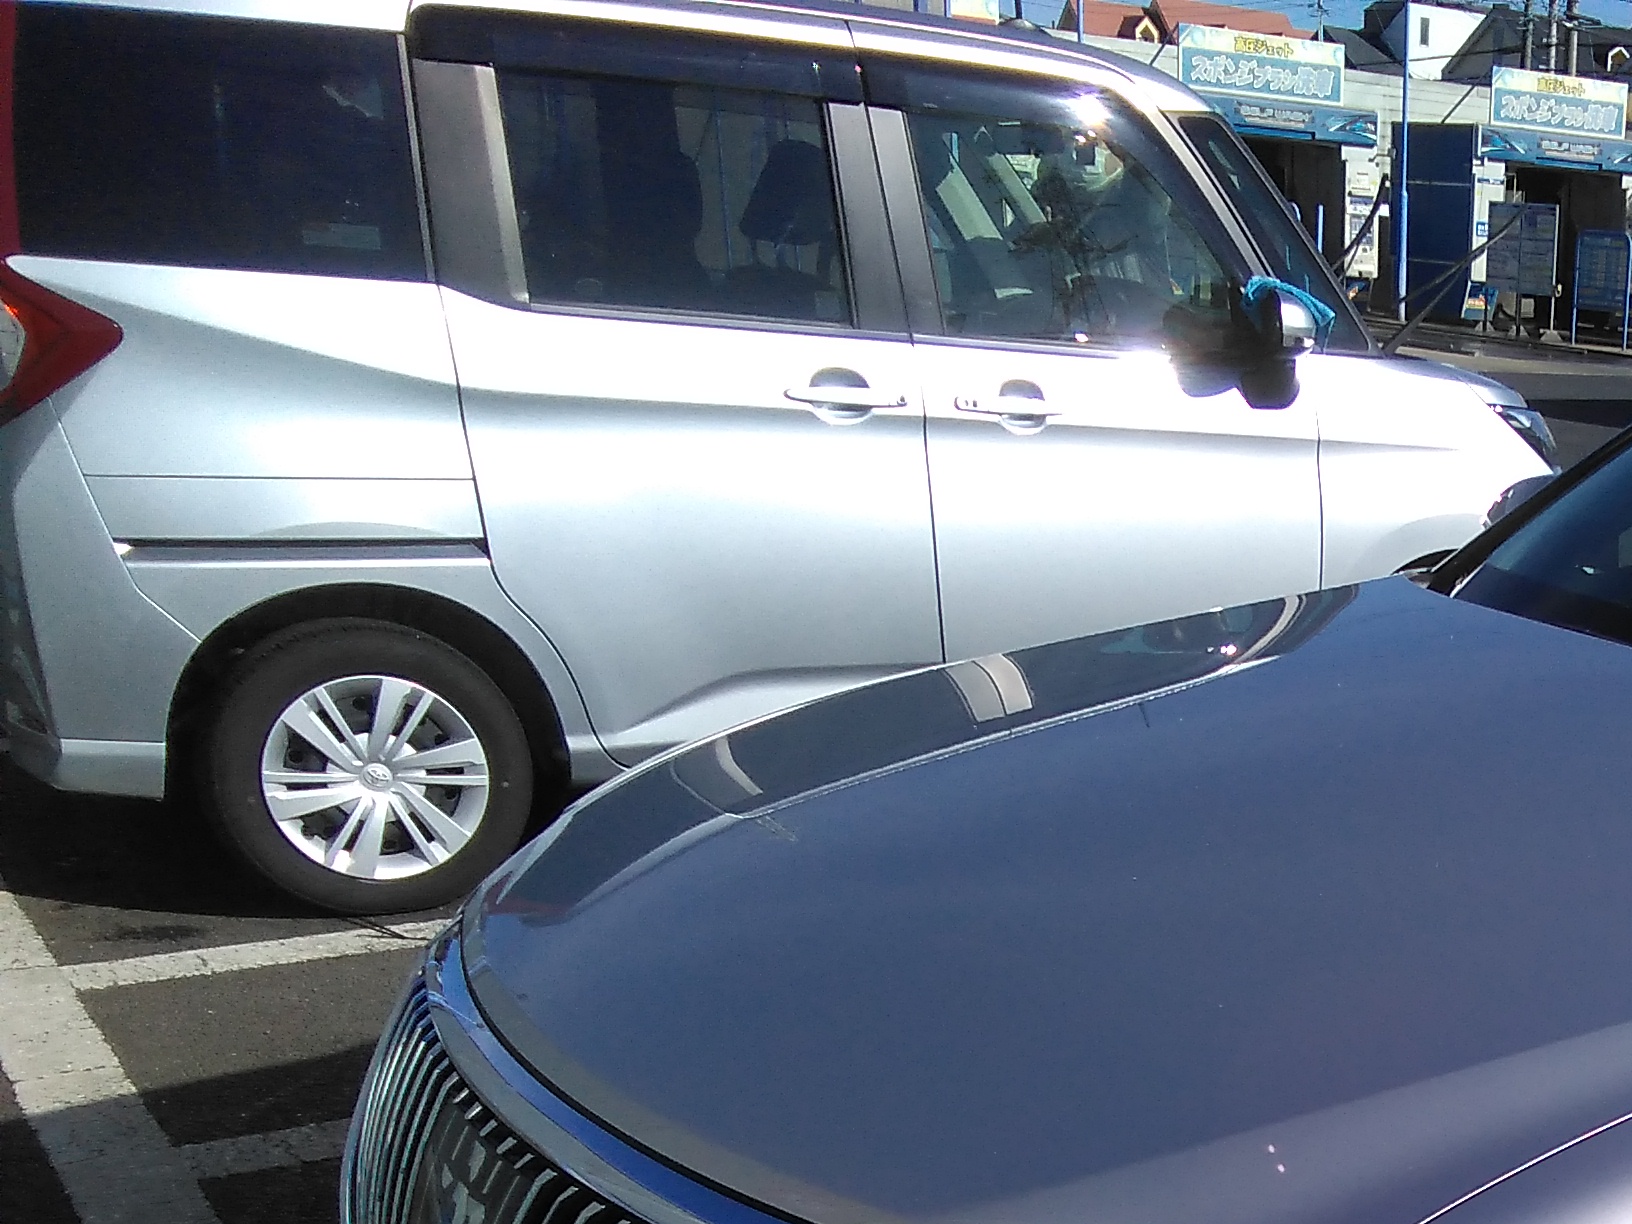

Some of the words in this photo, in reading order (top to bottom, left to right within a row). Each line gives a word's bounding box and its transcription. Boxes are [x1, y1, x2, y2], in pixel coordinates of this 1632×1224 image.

[1234, 36, 1294, 58] 高圧ジェット
[1537, 76, 1586, 97] 高圧ジェット
